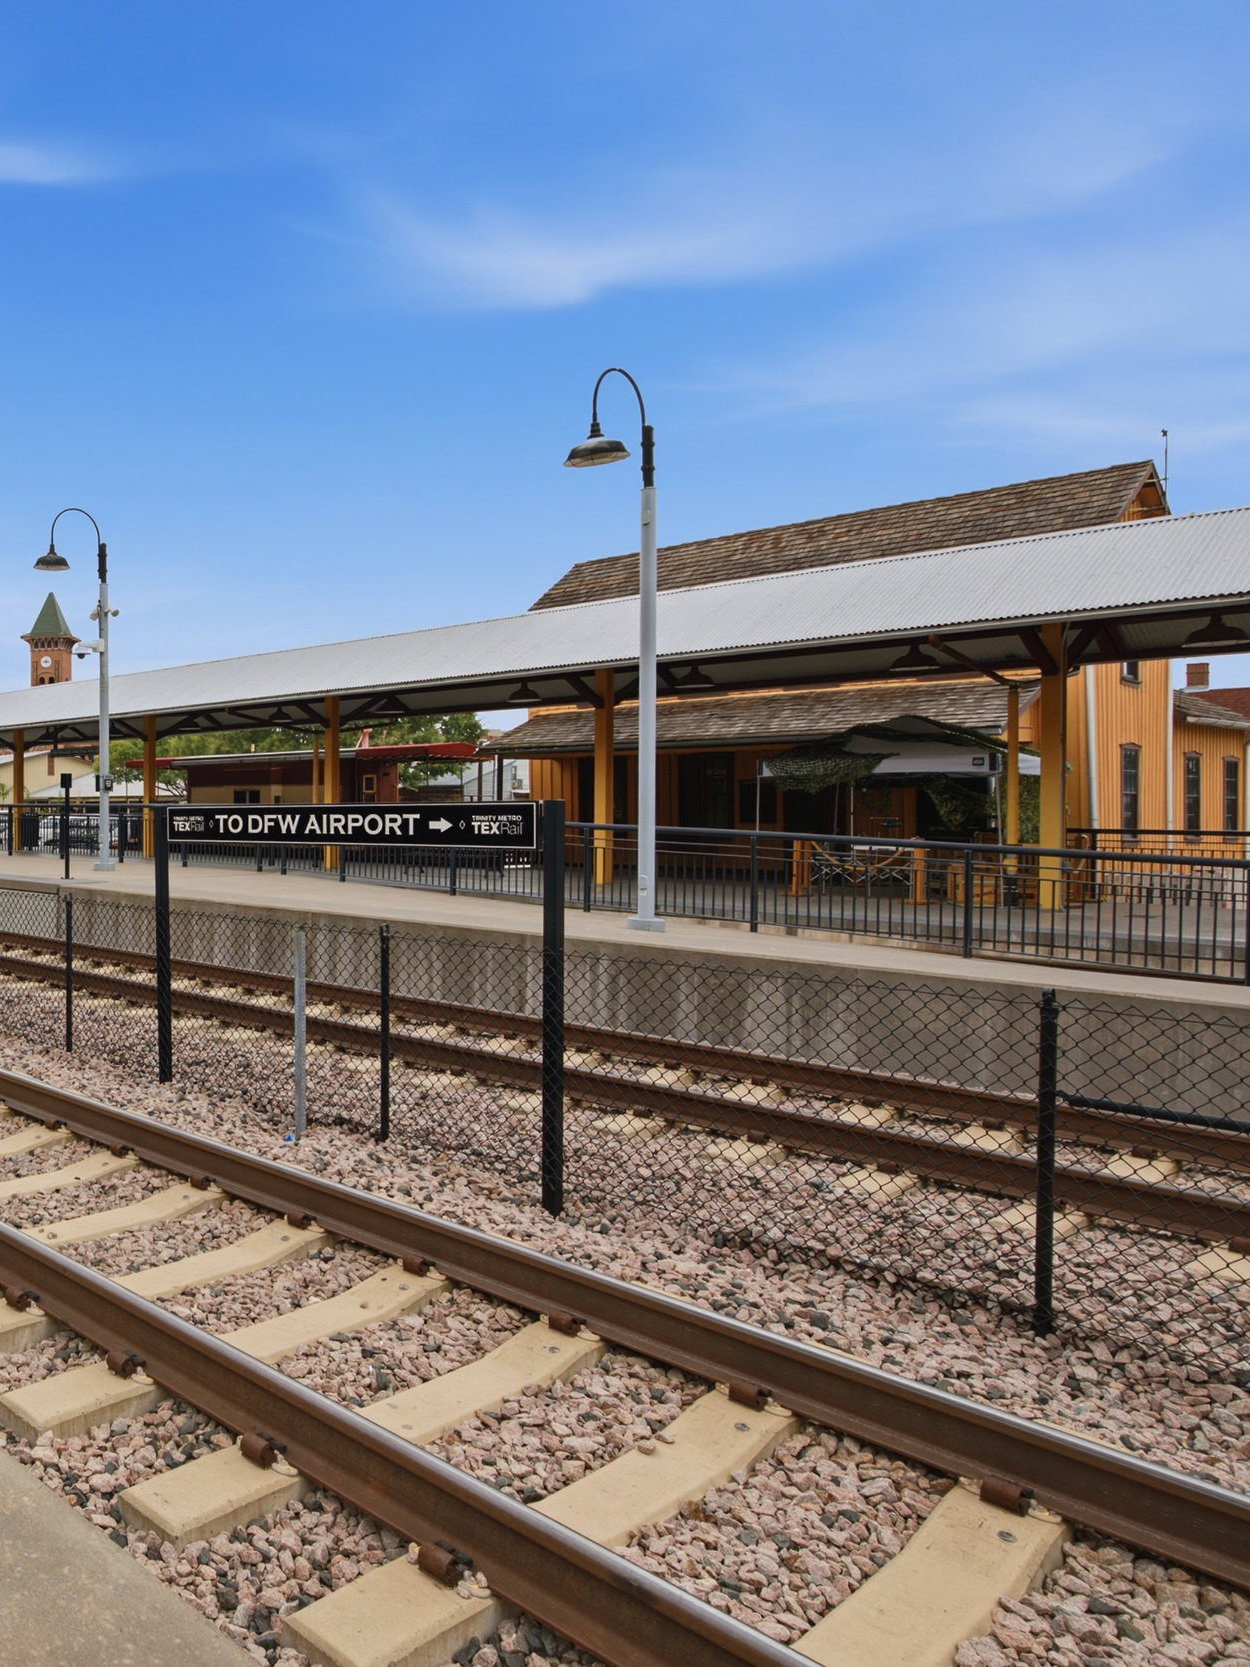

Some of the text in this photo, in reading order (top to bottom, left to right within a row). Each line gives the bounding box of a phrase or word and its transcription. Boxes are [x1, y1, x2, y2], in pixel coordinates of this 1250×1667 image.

[215, 814, 420, 835] TO DFW AIRPORT
[471, 821, 523, 835] TEXRail
